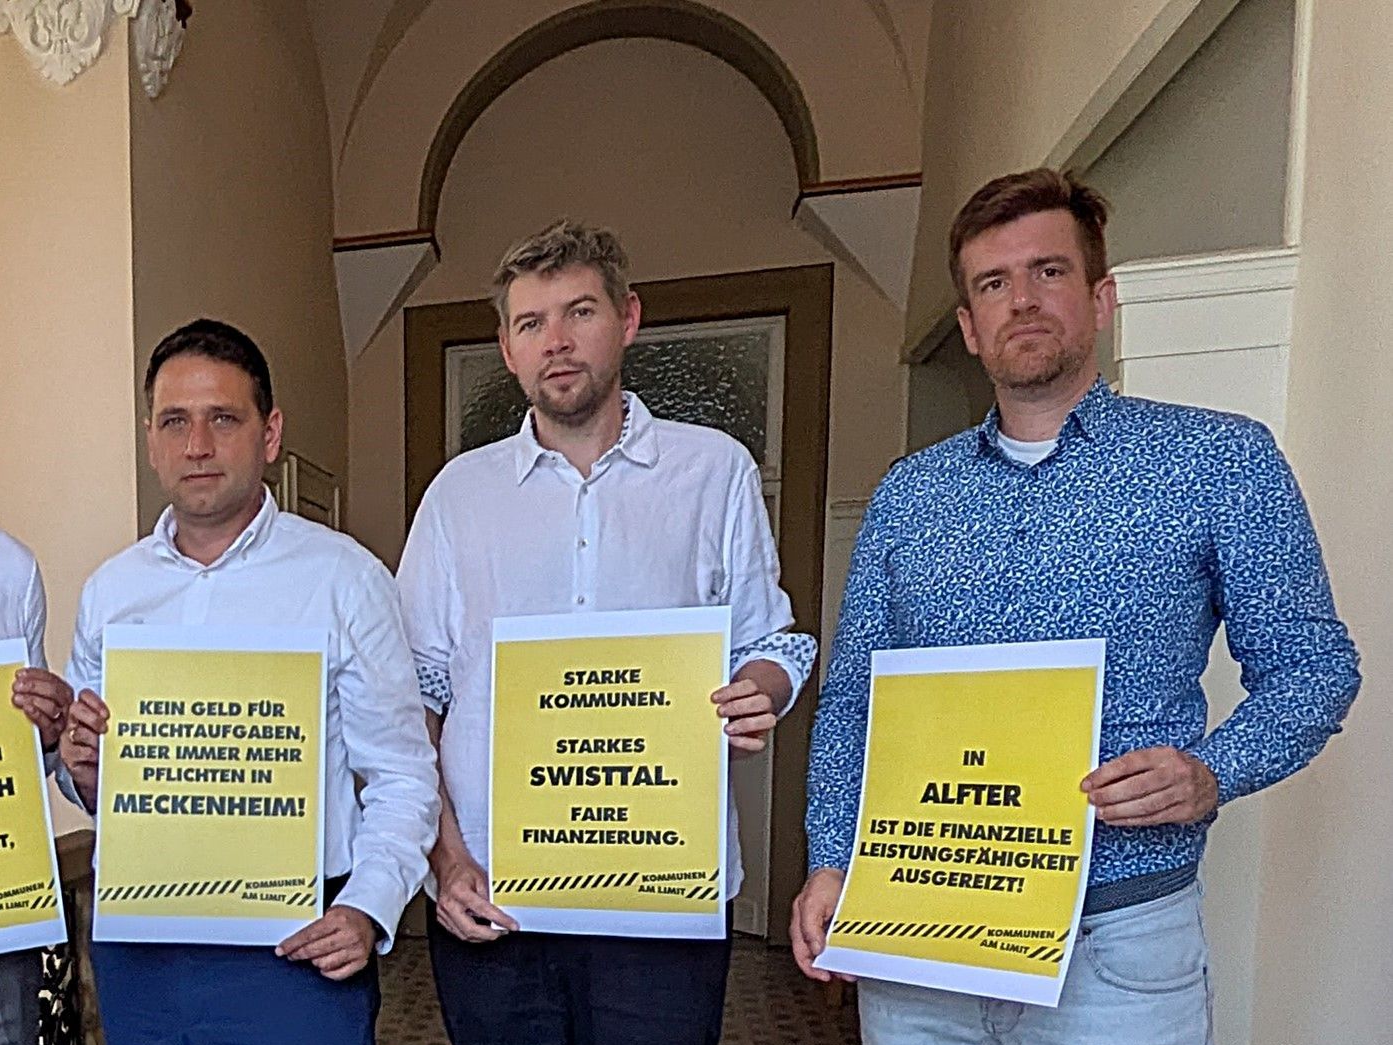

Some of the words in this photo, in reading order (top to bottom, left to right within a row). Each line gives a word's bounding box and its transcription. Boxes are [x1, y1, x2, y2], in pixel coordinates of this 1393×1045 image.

[563, 668, 641, 686] STARKE
[539, 691, 671, 709] KOMMUNEN.
[139, 700, 185, 715] KEIN
[191, 702, 242, 717] GELD
[247, 700, 285, 717] FÜR
[117, 723, 306, 742] PFLICHTAUFGABEN,
[120, 745, 171, 760] ABER
[176, 746, 240, 761] IMMER
[245, 748, 302, 762] MEHR
[556, 738, 645, 754] STARKES
[963, 750, 985, 766] IN
[142, 768, 245, 783] PFLICHTEN
[251, 769, 273, 783] IN
[530, 765, 678, 787] SWISTTAL.
[920, 782, 1022, 807] ALFTER
[113, 794, 306, 817] MECKENHEIM!
[570, 807, 629, 822] FAIRE
[522, 829, 685, 845] FINANZIERUNG.
[869, 819, 899, 835] IST
[902, 821, 934, 837] DIE
[940, 823, 1072, 845] FINANZIELLE
[859, 842, 1079, 872] LEISTUNGSFÄHIGKEIT
[245, 878, 306, 890] KOMMUNEN
[641, 871, 706, 883] KOMMUNEN
[890, 869, 1025, 893] AUSGEREIZT!
[241, 891, 258, 900] AM
[259, 893, 287, 902] LIMIT
[638, 885, 656, 894] AM
[657, 886, 686, 896] LIMIT
[5, 900, 30, 911] LIMIT
[987, 928, 1055, 939] KOMMUNEN
[979, 938, 998, 950] AM
[1000, 942, 1030, 954] LIMIT
